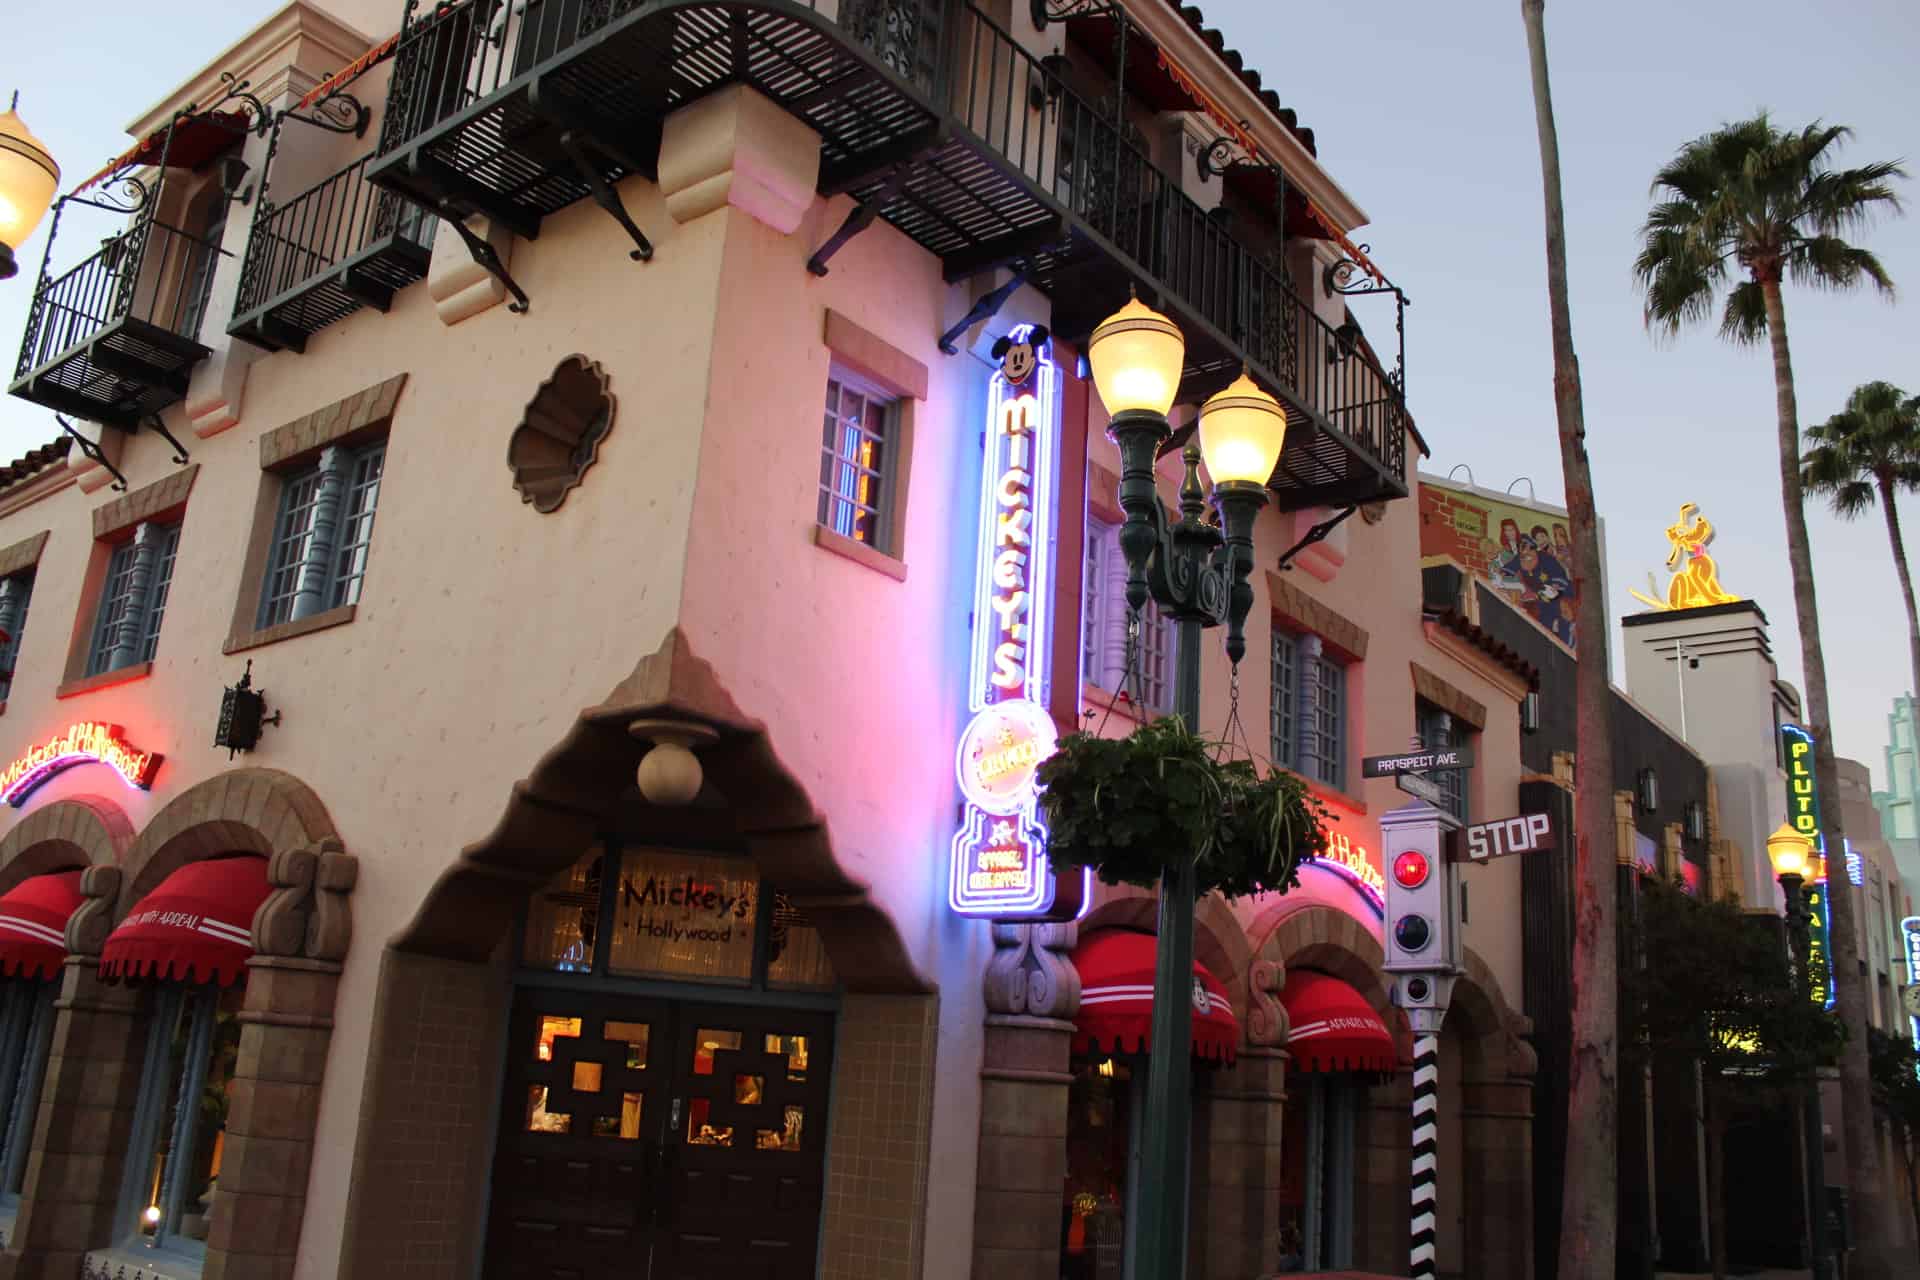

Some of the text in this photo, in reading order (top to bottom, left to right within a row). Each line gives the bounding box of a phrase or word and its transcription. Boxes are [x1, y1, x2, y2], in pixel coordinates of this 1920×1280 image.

[1377, 752, 1460, 772] PROSPECT AVE.
[1467, 813, 1550, 859] STOP
[623, 877, 750, 918] Mickey's
[636, 914, 731, 942] Hollywood
